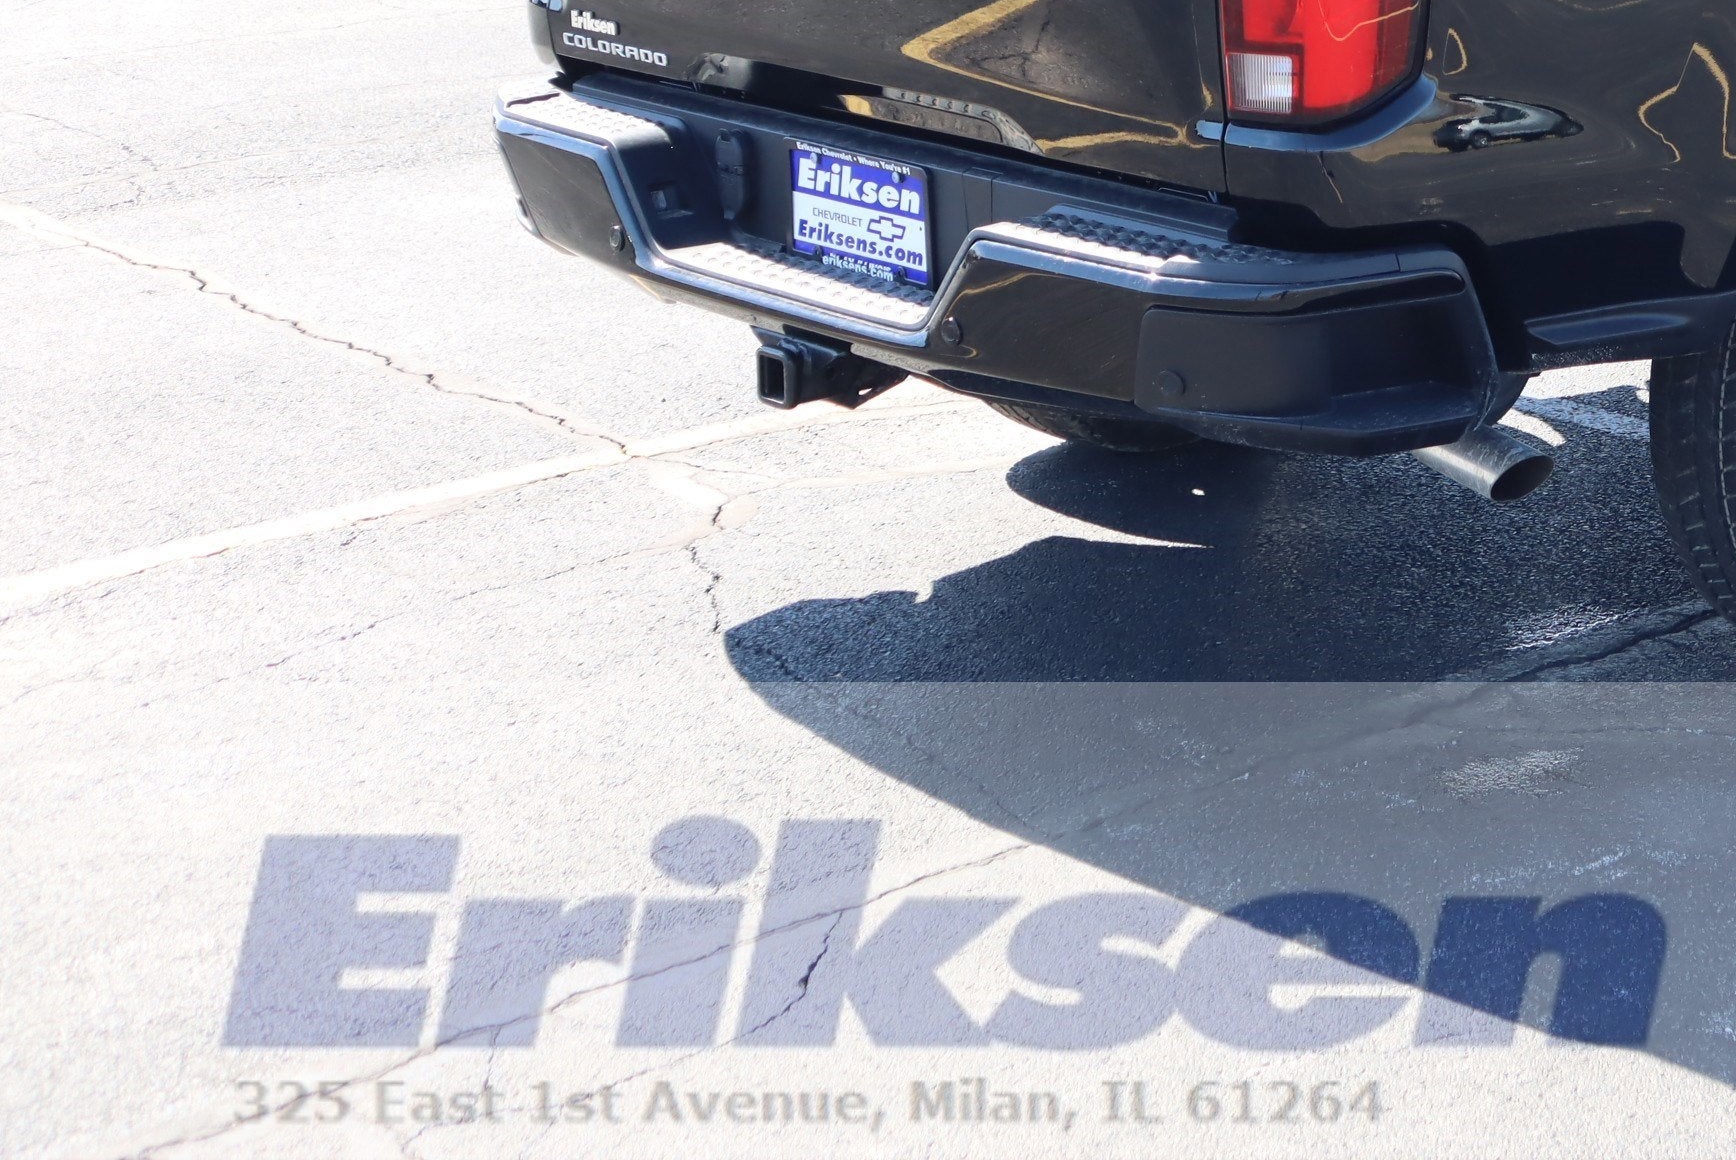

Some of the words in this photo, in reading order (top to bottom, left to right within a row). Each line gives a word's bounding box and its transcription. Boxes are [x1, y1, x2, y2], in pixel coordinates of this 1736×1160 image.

[570, 9, 617, 36] Eriksen
[563, 32, 667, 66] COLORADO
[796, 141, 822, 155] Eriksen
[857, 156, 880, 168] Where
[797, 157, 921, 215] Eriksen
[812, 207, 863, 228] CHEVROLET
[798, 218, 924, 267] Eriksens.com
[822, 254, 894, 282] eriksens.com
